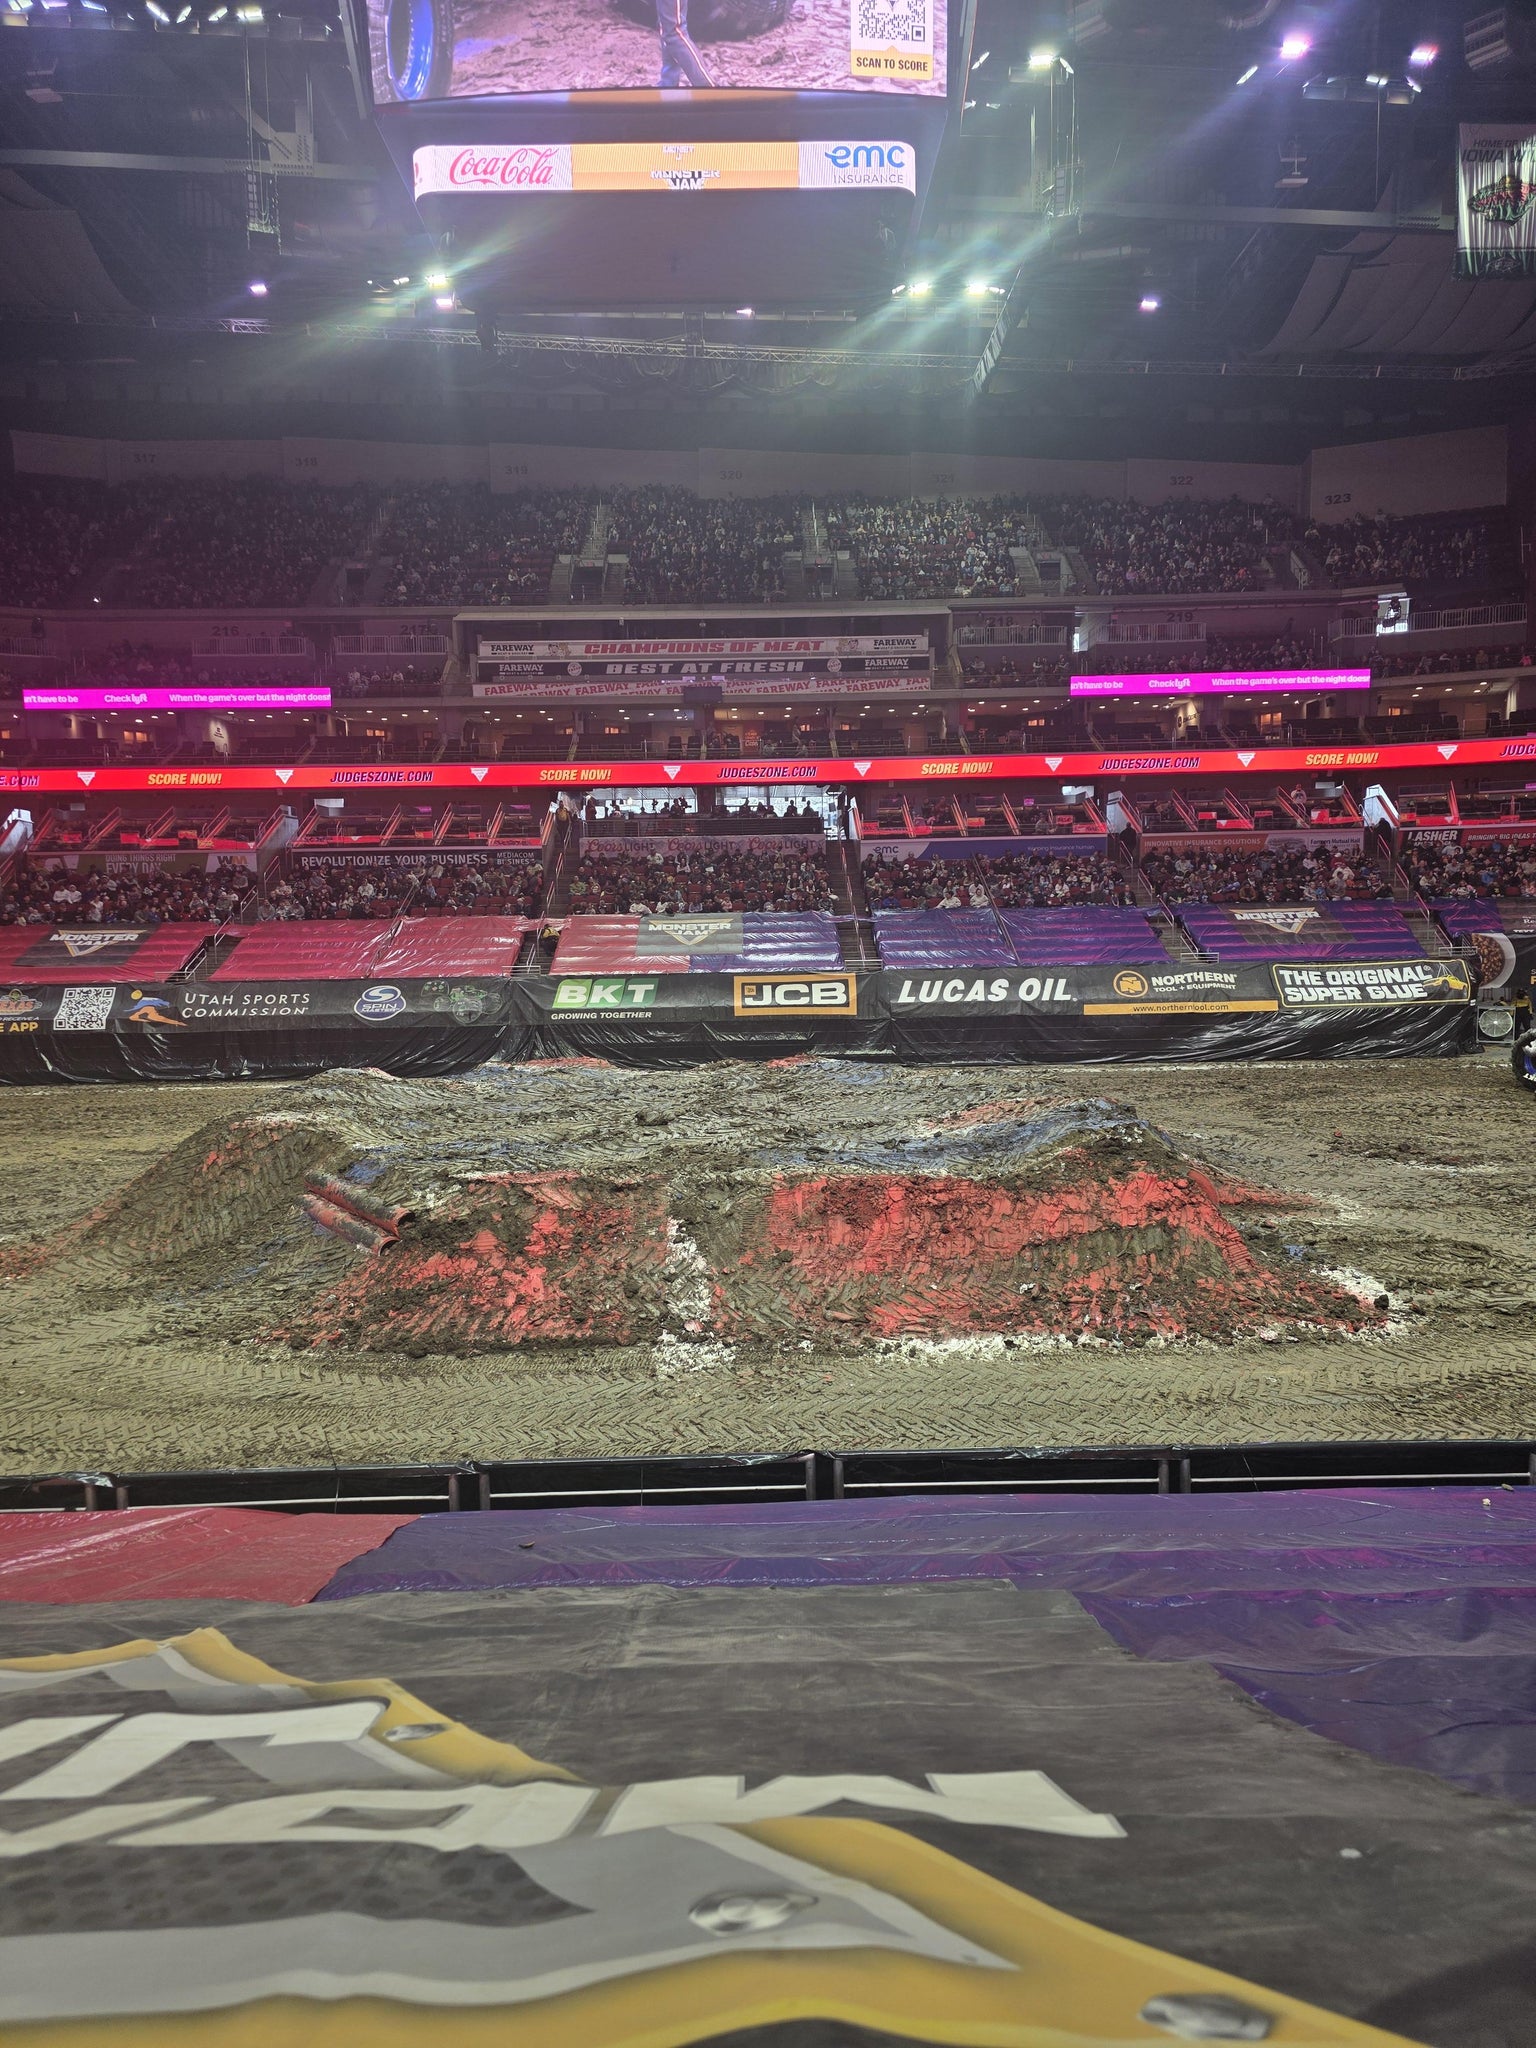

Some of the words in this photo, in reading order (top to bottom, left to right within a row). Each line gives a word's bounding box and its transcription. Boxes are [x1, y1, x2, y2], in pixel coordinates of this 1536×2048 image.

[856, 57, 881, 68] SCAN
[884, 59, 895, 69] TO
[898, 60, 928, 71] SCORE
[824, 145, 905, 169] emc
[1462, 150, 1504, 162] IOWA
[449, 148, 558, 185] Coca-Cola
[650, 170, 721, 179] MONSTER
[833, 174, 904, 184] INSURANCE
[668, 178, 704, 190] JAM
[133, 453, 156, 464] 317
[504, 464, 528, 475] 319
[719, 470, 742, 480] 320
[1169, 475, 1194, 486] 322
[1324, 493, 1352, 505] 323
[988, 616, 1014, 628] 218
[1167, 612, 1193, 623] 219
[211, 625, 240, 636] 216
[400, 624, 425, 636] 217
[584, 642, 721, 654] CHAMPIONS
[730, 641, 760, 652] OF
[763, 640, 824, 652] MEAT
[873, 638, 917, 647] FAREWAY
[606, 663, 674, 675] BEST
[680, 662, 713, 674] AT
[720, 661, 804, 673] FRESH
[864, 658, 909, 666] FAREWAY
[1084, 681, 1103, 690] have
[1103, 681, 1112, 689] to
[1112, 680, 1124, 689] be
[1148, 679, 1175, 688] Check
[1174, 678, 1191, 690] lyft
[1211, 678, 1235, 686] When
[1249, 677, 1278, 687] game's
[1278, 677, 1297, 685] over
[1297, 676, 1311, 684] but
[1311, 676, 1326, 684] the
[1325, 675, 1347, 685] night
[484, 682, 538, 696] FAREWAY
[575, 682, 629, 696] FAREWAY
[756, 680, 811, 694] FAREWAY
[846, 679, 900, 692] FAREWAY
[37, 695, 57, 703] have
[58, 695, 67, 703] to
[68, 695, 79, 703] be
[104, 694, 131, 703] Check
[131, 693, 148, 704] lyft
[169, 694, 193, 702] When
[193, 694, 207, 702] the
[208, 694, 238, 703] game's
[285, 693, 307, 703] night
[147, 774, 187, 785] SCORE
[189, 773, 222, 785] NOW!
[330, 770, 434, 784] JUDGESZONE.COM
[539, 769, 577, 782] SCORE
[580, 769, 613, 781] NOW!
[716, 766, 818, 779] JUDGESZONE.COM
[921, 763, 959, 776] SCORE
[961, 762, 994, 775] NOW!
[1098, 756, 1200, 771] JUDGESZONE.COM
[1305, 753, 1344, 766] SCORE
[1346, 752, 1379, 764] NOW!
[587, 839, 623, 852] Coors
[624, 842, 655, 852] LIGHT
[667, 838, 702, 852] Coors
[703, 841, 735, 852] LIGHT
[749, 837, 784, 851] Coors
[784, 840, 815, 850] LIGHT
[872, 845, 899, 854] emc
[105, 854, 128, 862] DOING
[129, 854, 155, 862] THINGS
[155, 853, 176, 862] RIGHT
[301, 855, 391, 867] REVOLUTIONIZE
[394, 855, 427, 865] YOUR
[431, 854, 488, 865] BUSINESS
[142, 862, 162, 874] DAY
[1234, 910, 1321, 921] MONSTER
[648, 922, 731, 931] MONSTER
[50, 933, 140, 941] MONSTER
[1151, 971, 1235, 986] NORTHERN
[1279, 969, 1324, 987] THE
[1325, 965, 1433, 986] ORIGINAL
[896, 979, 1011, 1003] LUCAS
[1018, 977, 1072, 1001] OIL
[1186, 982, 1237, 990] EQUIPMENT
[555, 984, 655, 1004] BKT
[744, 982, 847, 1006] JCB
[1285, 986, 1362, 1002] SUPER
[1367, 983, 1428, 999] GLUE
[0, 1000, 34, 1010] EXAS
[184, 993, 234, 1005] UTAH
[243, 993, 310, 1005] SPORTS
[181, 1006, 309, 1018] COMMISSION
[551, 1011, 598, 1021] GROWING
[599, 1010, 652, 1019] TOGETHER
[9, 1021, 39, 1033] APP
